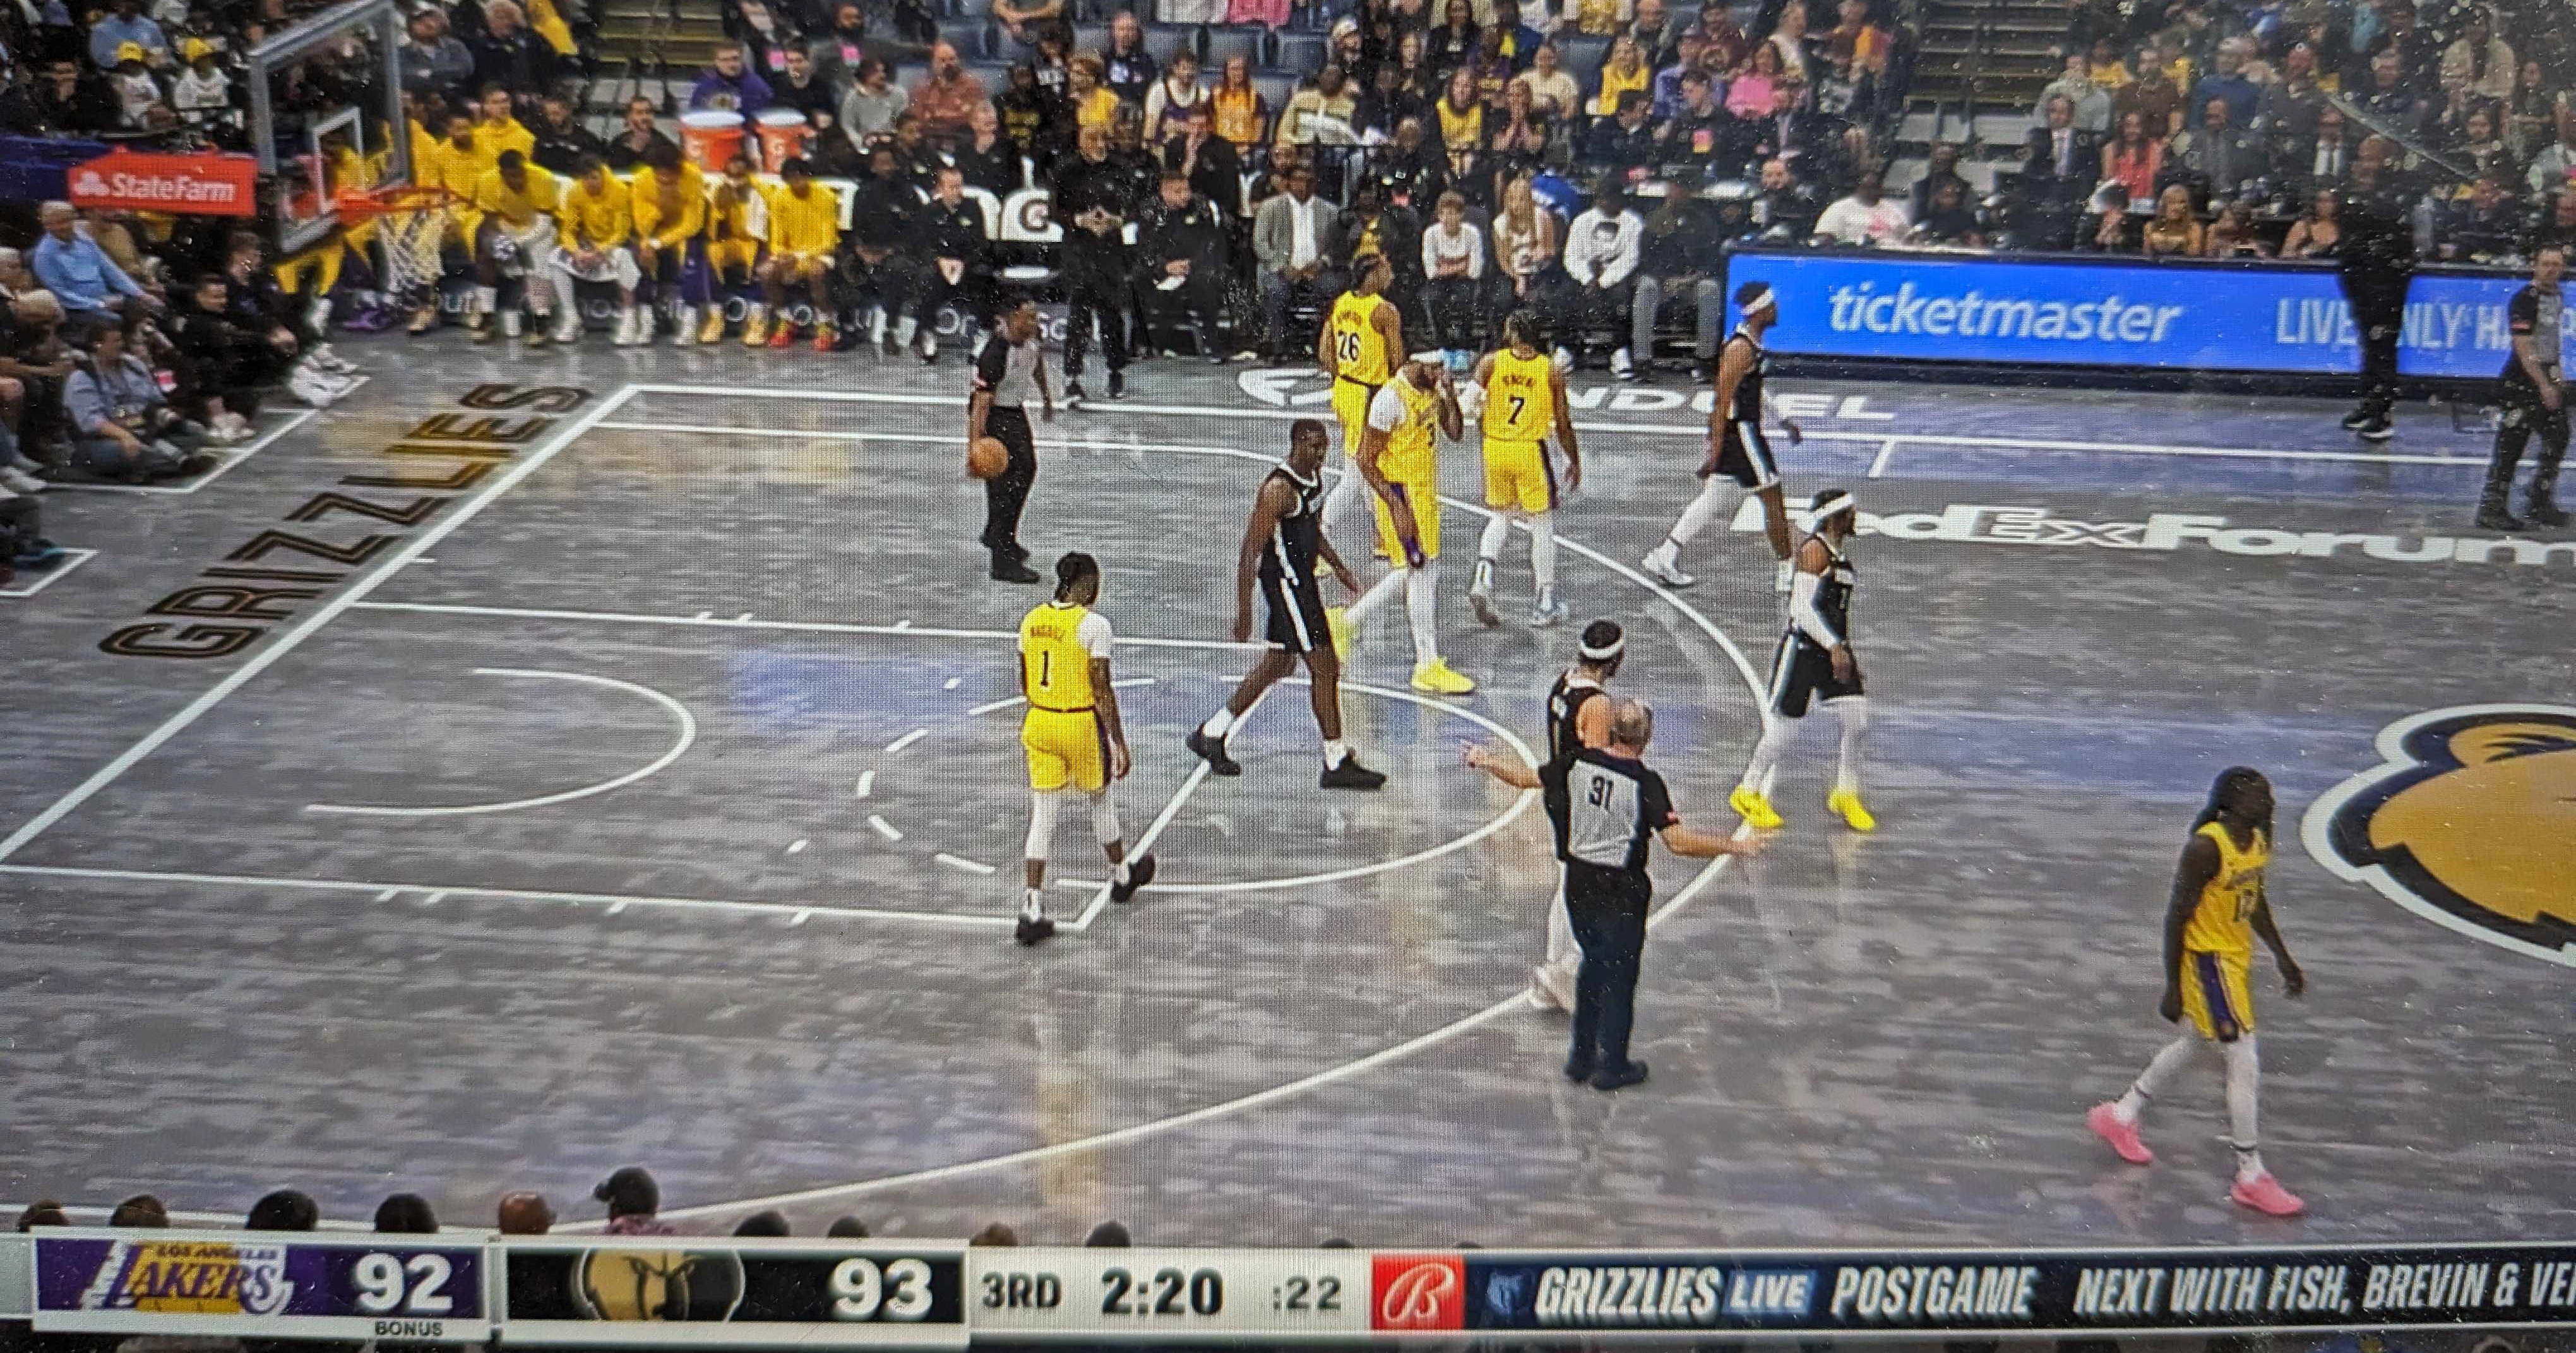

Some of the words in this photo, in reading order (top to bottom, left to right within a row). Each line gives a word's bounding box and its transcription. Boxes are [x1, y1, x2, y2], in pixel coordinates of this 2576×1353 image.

[111, 172, 236, 202] StateFarm
[1829, 280, 2183, 342] ticketmaster
[2397, 303, 2467, 349] NLY
[1337, 330, 1360, 363] 26
[1508, 393, 1525, 426] 7
[98, 383, 595, 659] GRIZZLIES
[1040, 650, 1049, 688] 1
[1587, 774, 1613, 812] 31
[93, 1245, 285, 1314] LAKERS
[355, 1253, 453, 1311] 92
[828, 1258, 933, 1321] 93
[982, 1271, 1063, 1309] 3RD
[1101, 1267, 1224, 1316] 2:20
[1273, 1276, 1342, 1311] :22
[1535, 1266, 1722, 1316] GRIZZLIES
[1729, 1274, 1807, 1311] LIVE
[1831, 1267, 2038, 1316] POSTGAME
[2073, 1268, 2162, 1314] NEXT
[2169, 1268, 2262, 1314] WITH
[2268, 1267, 2354, 1314] FISH,
[2363, 1265, 2488, 1309] BREVIN
[2493, 1262, 2519, 1308] &
[374, 1320, 444, 1337] BONUS
